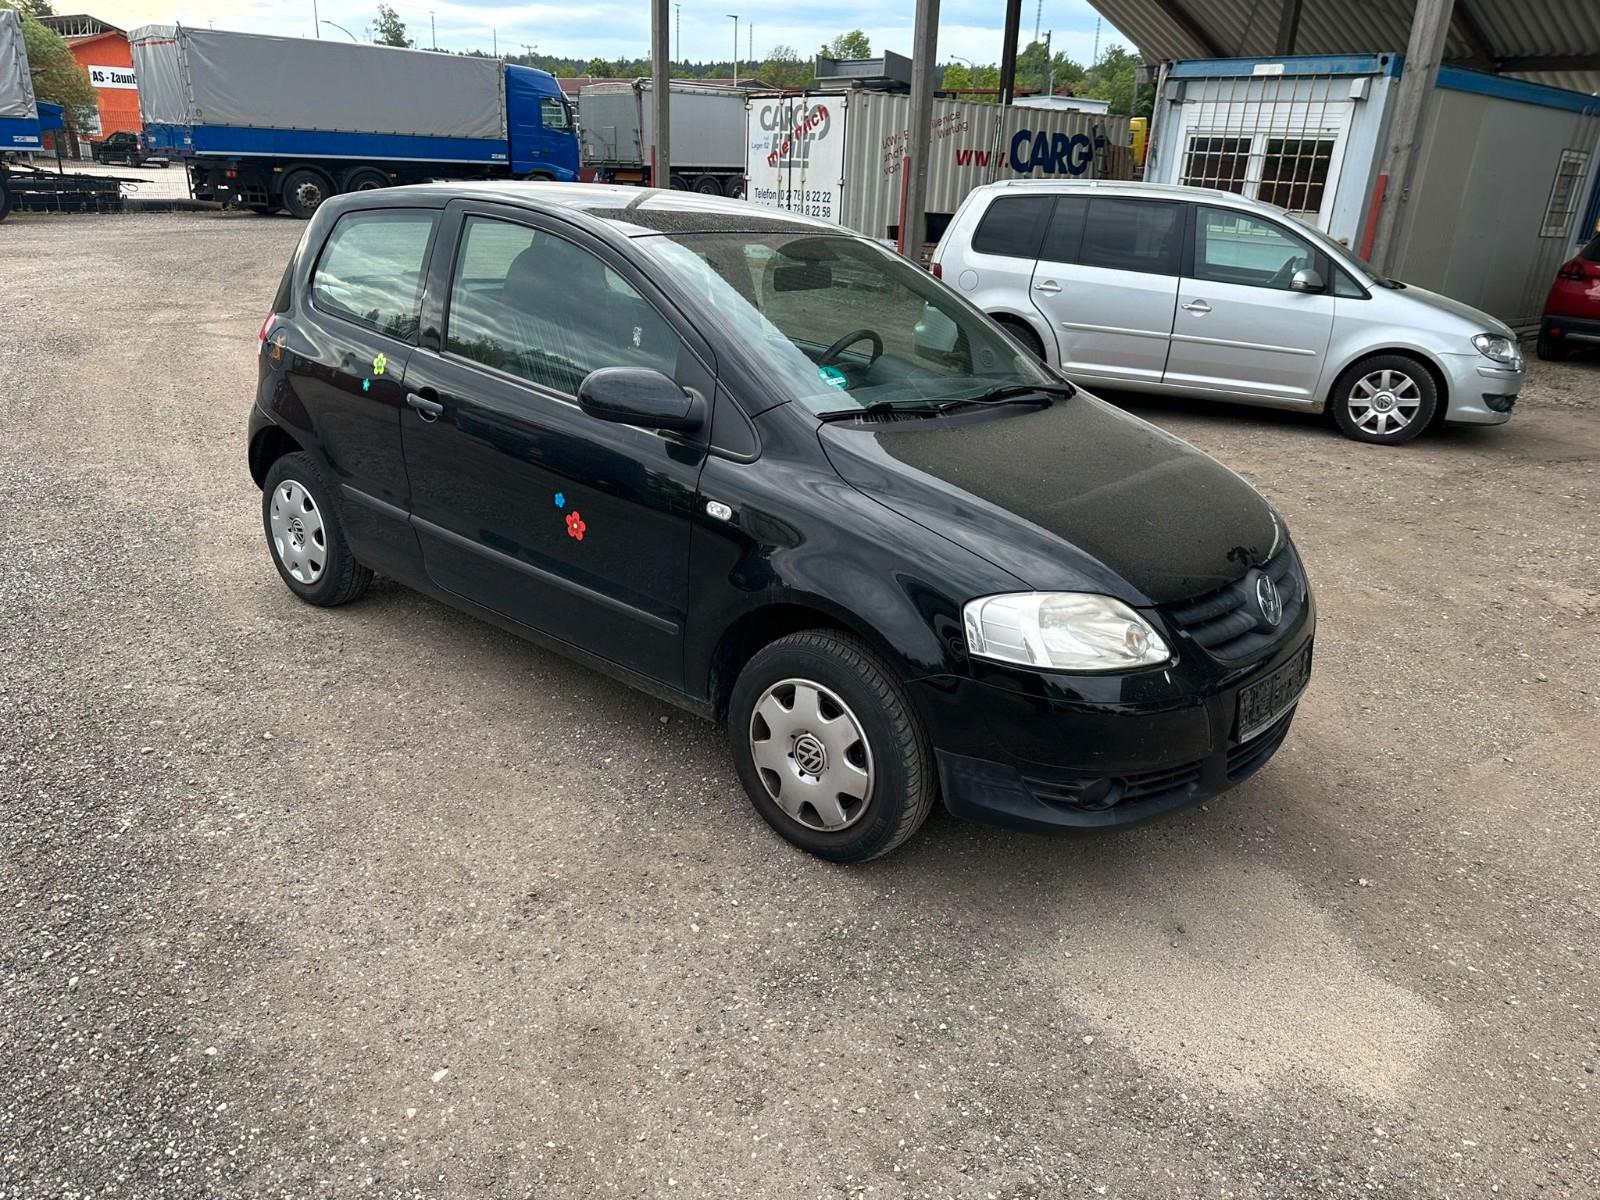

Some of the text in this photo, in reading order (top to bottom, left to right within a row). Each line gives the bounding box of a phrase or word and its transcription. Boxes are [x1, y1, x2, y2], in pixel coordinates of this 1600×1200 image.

[92, 70, 105, 82] AS
[754, 188, 776, 200] Telefon
[805, 191, 810, 202] 8
[812, 191, 820, 202] 22
[822, 192, 831, 203] 22
[805, 205, 810, 216] 8
[812, 205, 820, 217] 22
[822, 206, 831, 218] 58
